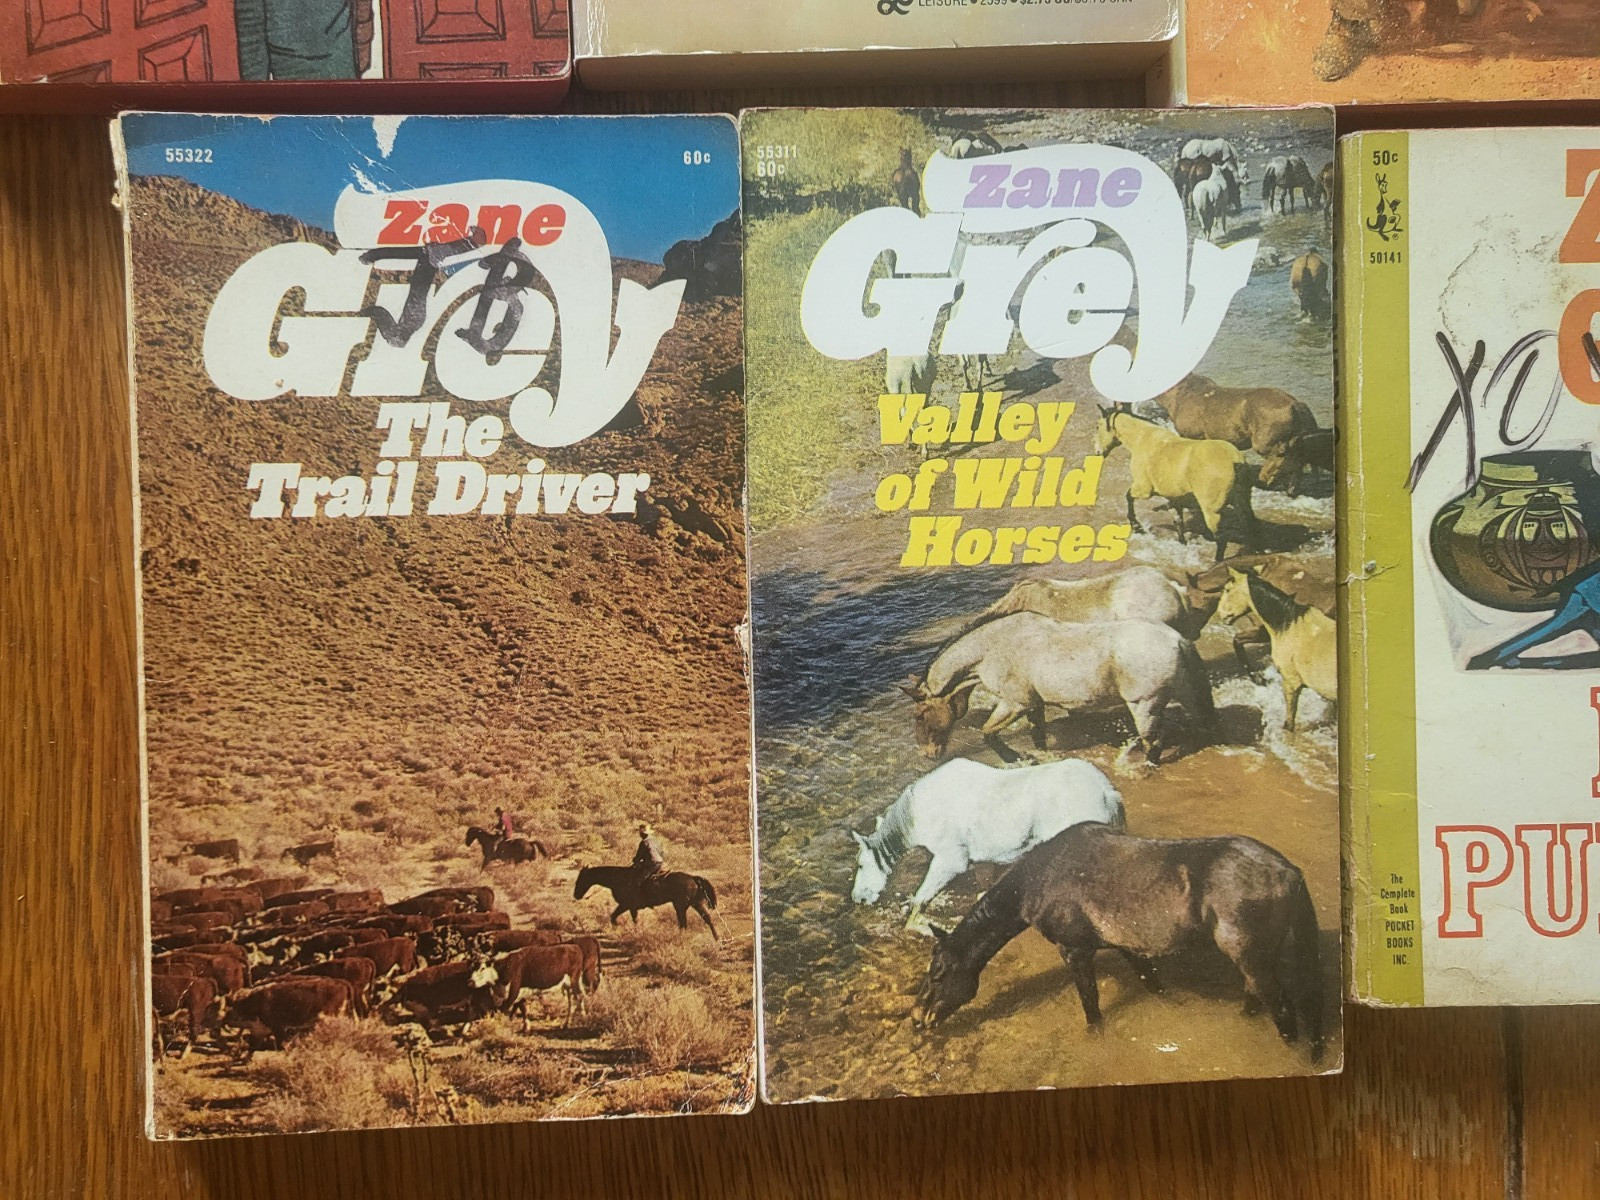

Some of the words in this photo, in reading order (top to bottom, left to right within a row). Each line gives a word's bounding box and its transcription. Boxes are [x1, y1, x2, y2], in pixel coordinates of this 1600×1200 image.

[165, 147, 213, 163] 55322
[756, 145, 798, 159] 55311
[1369, 251, 1402, 265] 50141
[799, 143, 1260, 403] Grey
[202, 178, 688, 448] Grey
[375, 401, 504, 457] The
[876, 392, 1076, 455] Valley
[246, 461, 418, 519] Trail
[433, 458, 651, 516] Driver
[875, 457, 949, 512] of
[951, 455, 1105, 510] Wild
[899, 515, 1132, 568] Horses
[1390, 873, 1404, 884] The
[1380, 887, 1416, 900] Complete
[1389, 903, 1409, 915] Book
[1385, 920, 1415, 932] POCKET
[1386, 937, 1414, 949] BOOKS
